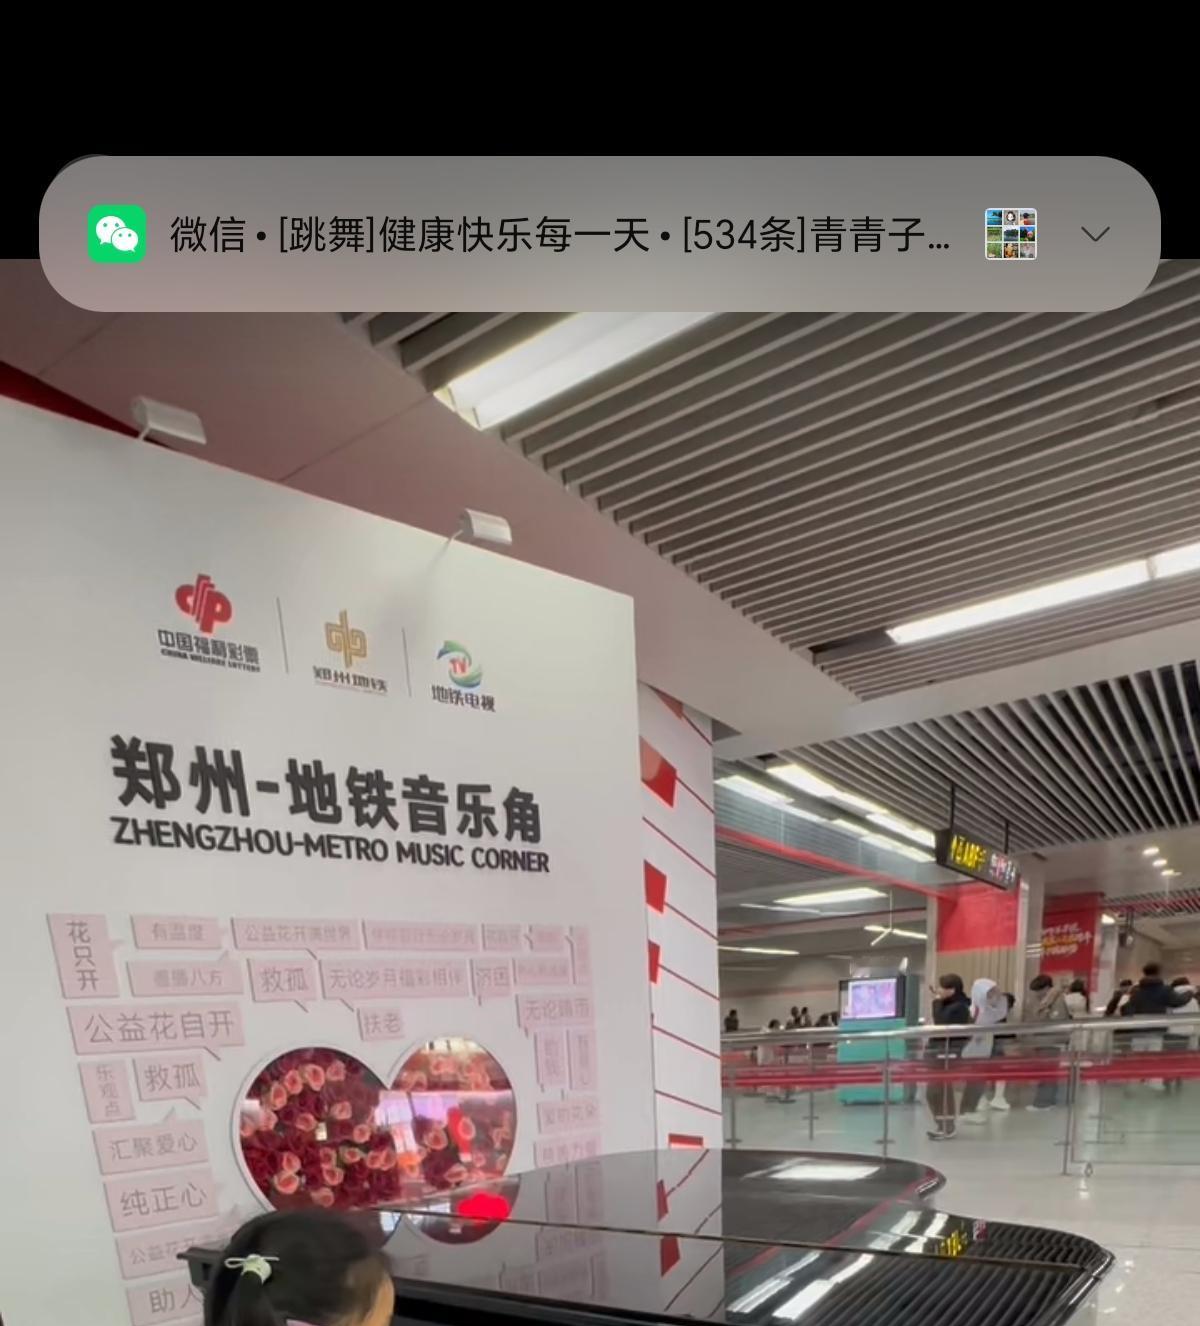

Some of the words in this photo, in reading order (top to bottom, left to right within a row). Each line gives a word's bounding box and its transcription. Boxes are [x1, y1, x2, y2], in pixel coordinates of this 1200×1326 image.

[312, 665, 389, 693] 郑州地铁
[430, 685, 496, 713] 地铁电视
[110, 734, 542, 844] 郑州-地铁音乐角
[109, 815, 390, 862] ZHENGZHOU-METRO
[395, 840, 465, 868] MUSIC
[470, 846, 550, 873] CORNER
[66, 920, 99, 991] 花只开
[85, 1010, 235, 1044] 公益花自开
[144, 1063, 201, 1093] 救孤
[110, 1131, 199, 1162] 汇聚爱心
[120, 1182, 208, 1218] 纯正心
